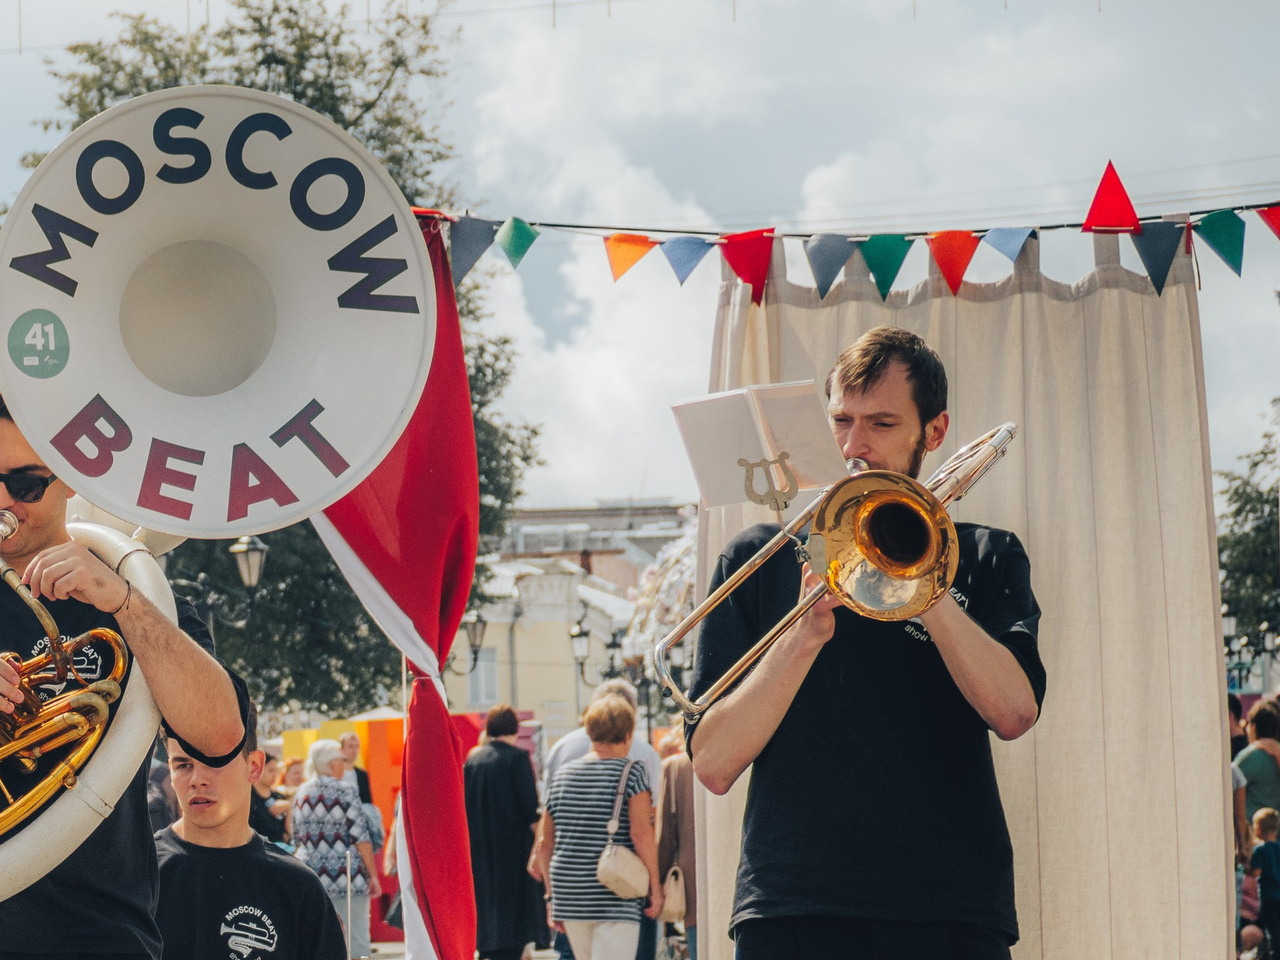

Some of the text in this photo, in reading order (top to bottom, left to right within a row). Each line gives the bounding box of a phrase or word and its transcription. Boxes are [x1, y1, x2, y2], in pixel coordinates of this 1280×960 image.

[9, 107, 420, 314] MOSCOW
[24, 322, 56, 350] 41
[49, 393, 351, 522] BEAT
[948, 587, 967, 602] EAT
[904, 624, 928, 641] show
[82, 645, 98, 659] EAT
[225, 905, 276, 935] MOSCOW BEAT
